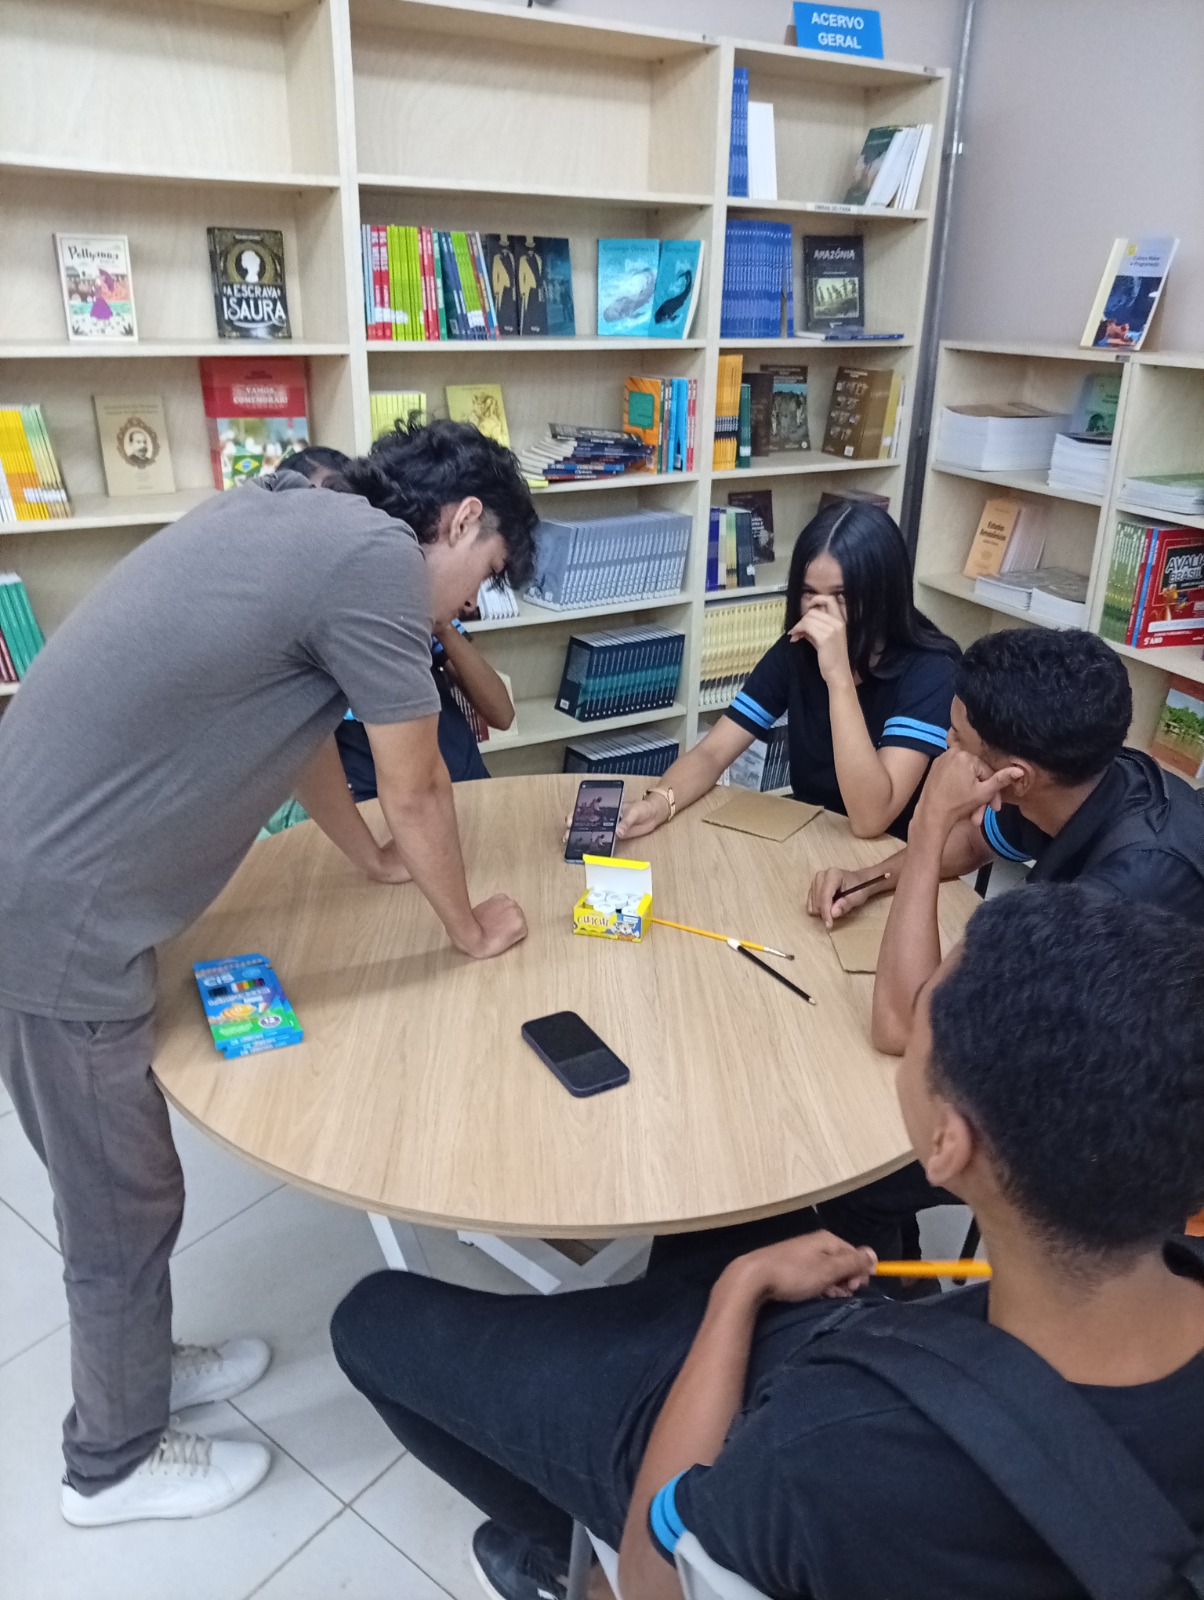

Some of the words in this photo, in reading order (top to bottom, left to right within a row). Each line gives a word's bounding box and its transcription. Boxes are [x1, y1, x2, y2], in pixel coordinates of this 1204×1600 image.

[811, 12, 865, 30] ACERVO
[817, 32, 862, 50] GERAL
[233, 284, 278, 299] ESCRAVA
[222, 296, 287, 328] ISAURA
[1165, 553, 1204, 574] AVALI
[1168, 567, 1203, 584] BRASIL
